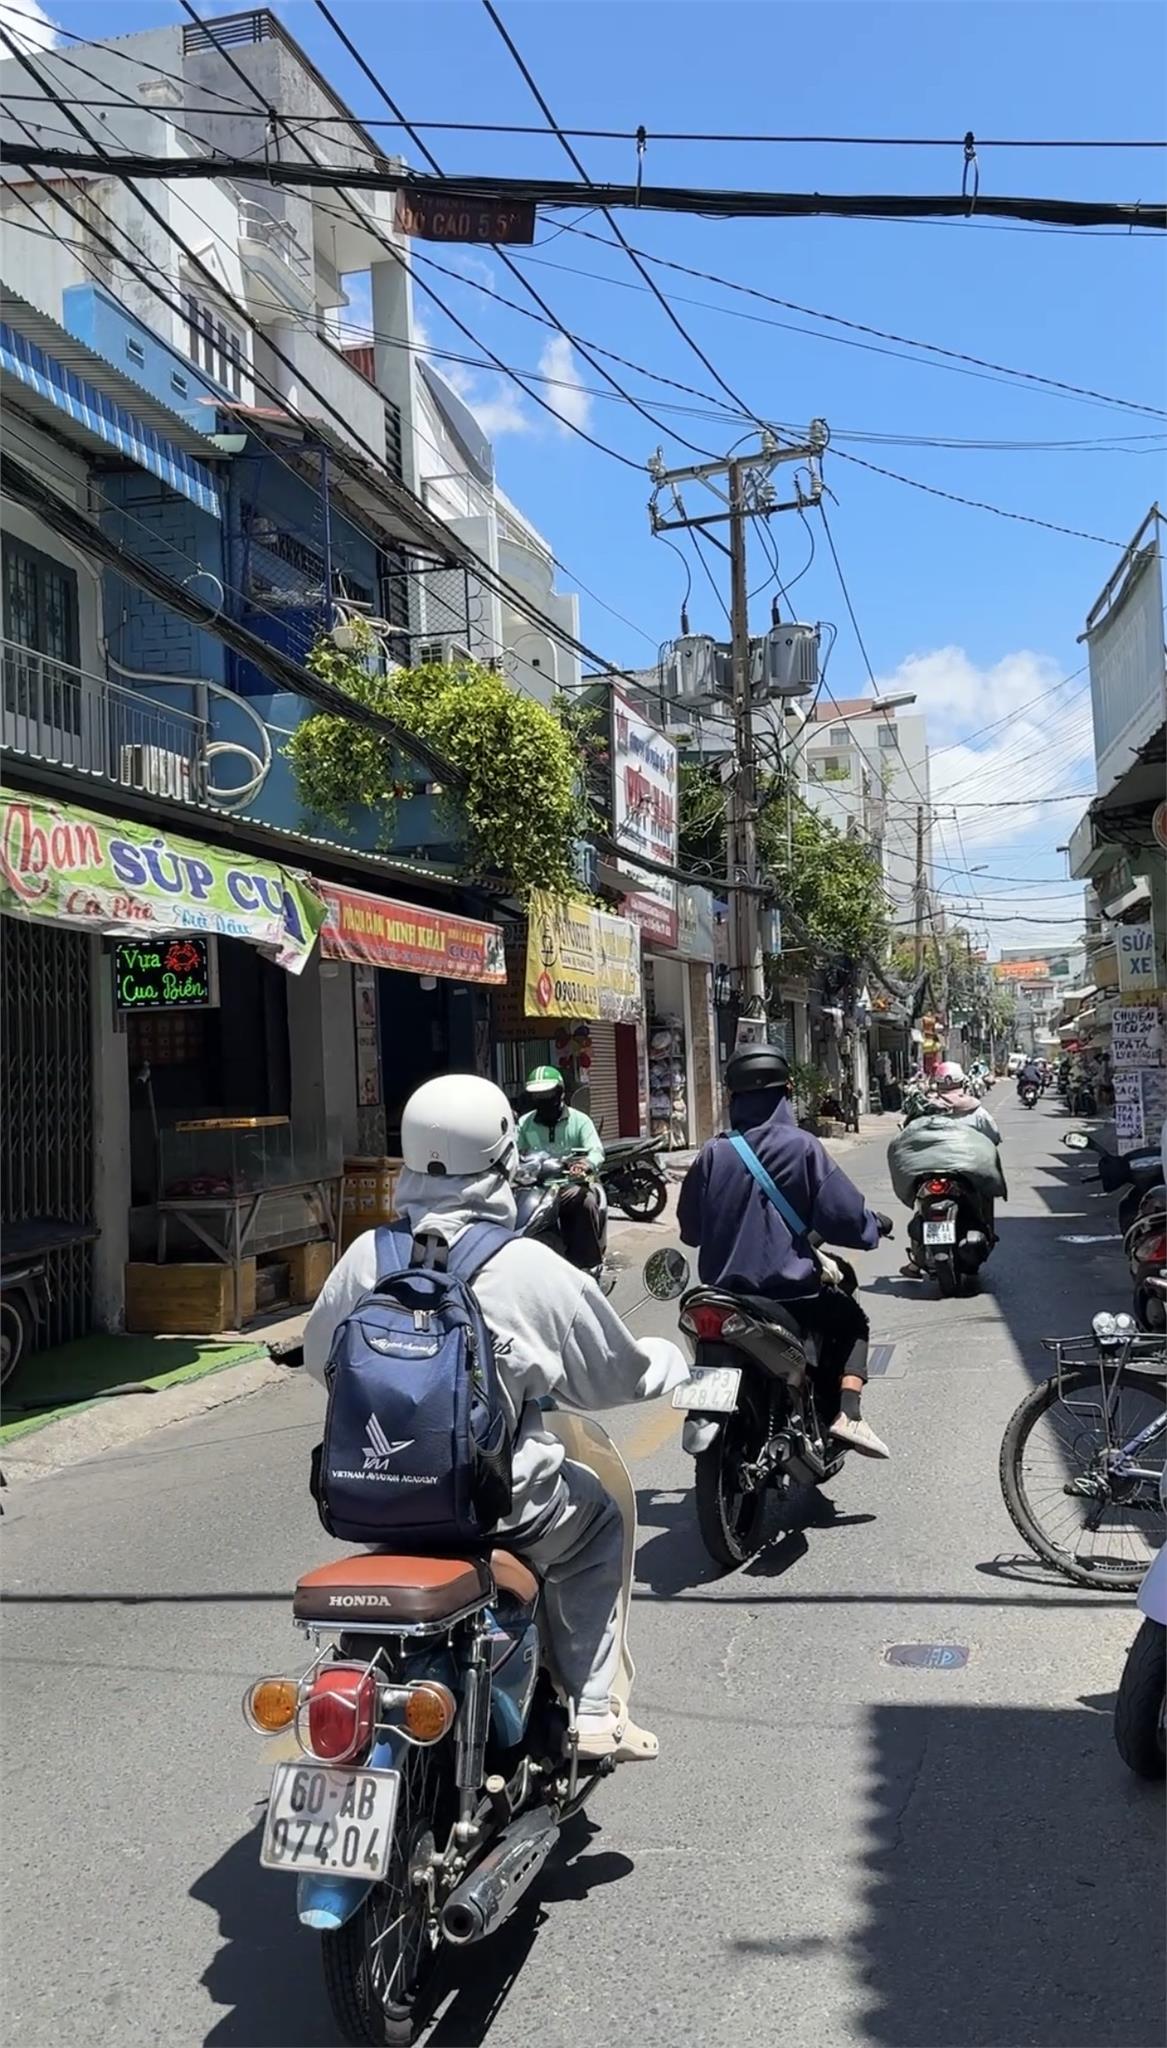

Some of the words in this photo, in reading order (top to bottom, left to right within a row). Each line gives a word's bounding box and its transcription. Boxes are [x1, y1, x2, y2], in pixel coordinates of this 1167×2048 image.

[433, 212, 470, 236] CAO
[386, 918, 416, 946] MINH
[122, 949, 162, 972] Vựa
[1130, 957, 1152, 975] XE
[122, 975, 158, 1001] Cua
[162, 972, 204, 1000] Biển
[332, 1470, 366, 1480] VIETNAM
[366, 1472, 400, 1483] AVIATION
[401, 1475, 439, 1485] ACADEMY
[328, 1595, 391, 1607] HONDA
[290, 1771, 377, 1820] 60-AB
[271, 1817, 380, 1871] 074.04
